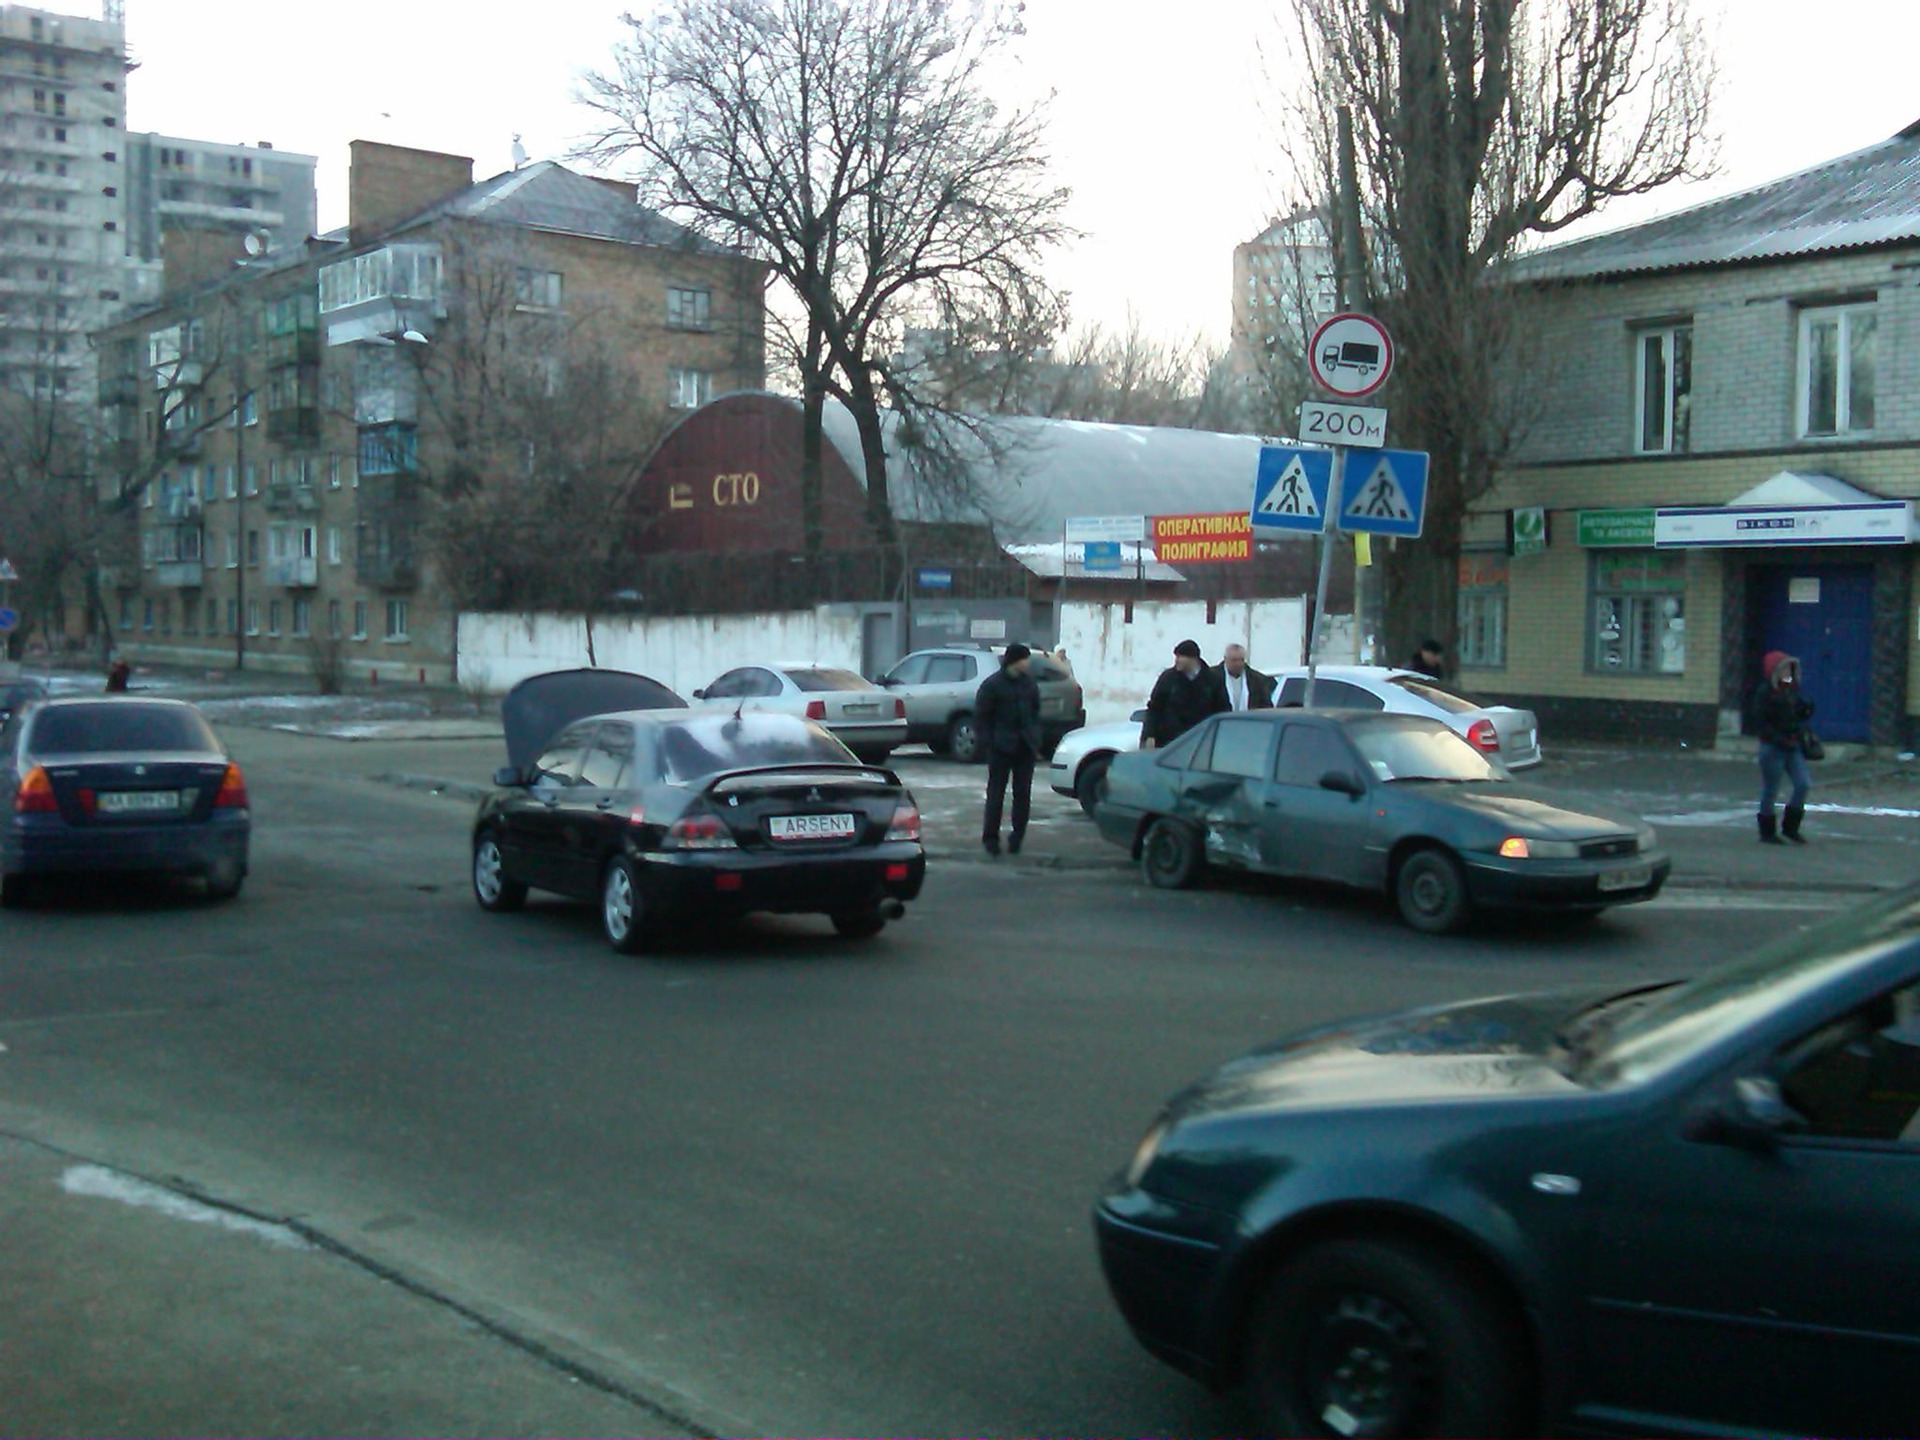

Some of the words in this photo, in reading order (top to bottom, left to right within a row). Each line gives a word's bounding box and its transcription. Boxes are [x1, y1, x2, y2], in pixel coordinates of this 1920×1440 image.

[713, 472, 759, 506] СТО
[1157, 515, 1250, 537] ОПЕРАТИВНАЯ
[1161, 540, 1248, 561] ПОЛИГРАФИЯ
[785, 815, 851, 833] ARSENY
